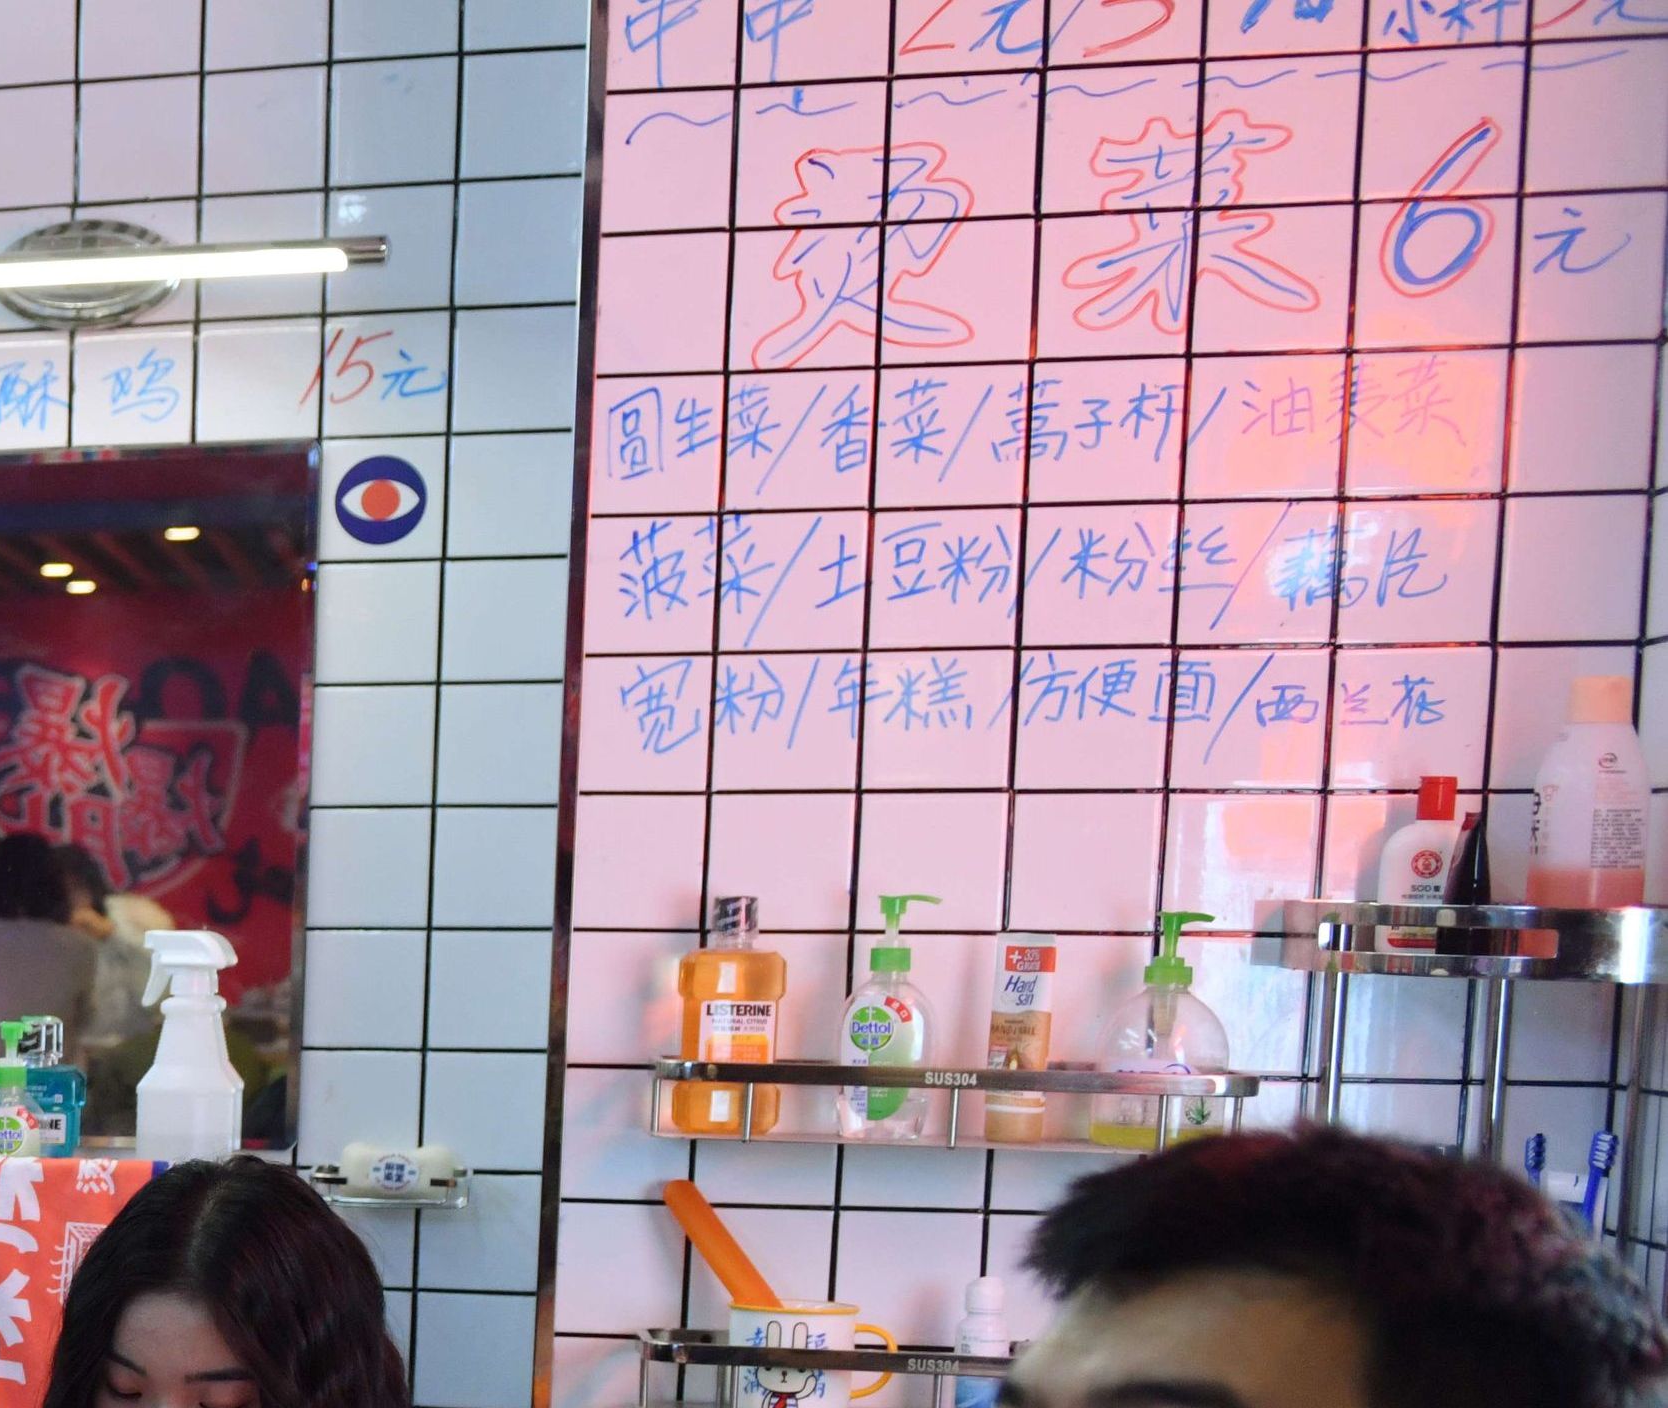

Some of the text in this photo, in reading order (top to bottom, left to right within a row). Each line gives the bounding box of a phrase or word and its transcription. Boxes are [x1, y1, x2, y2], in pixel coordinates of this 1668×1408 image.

[752, 110, 1318, 369] 烫菜
[1004, 974, 1038, 994] Hand
[1015, 993, 1034, 1007] san
[706, 1004, 771, 1017] LISTERINE
[851, 1021, 892, 1034] Dettol
[924, 1071, 978, 1088] SUS304
[907, 1357, 960, 1374] SUS304
